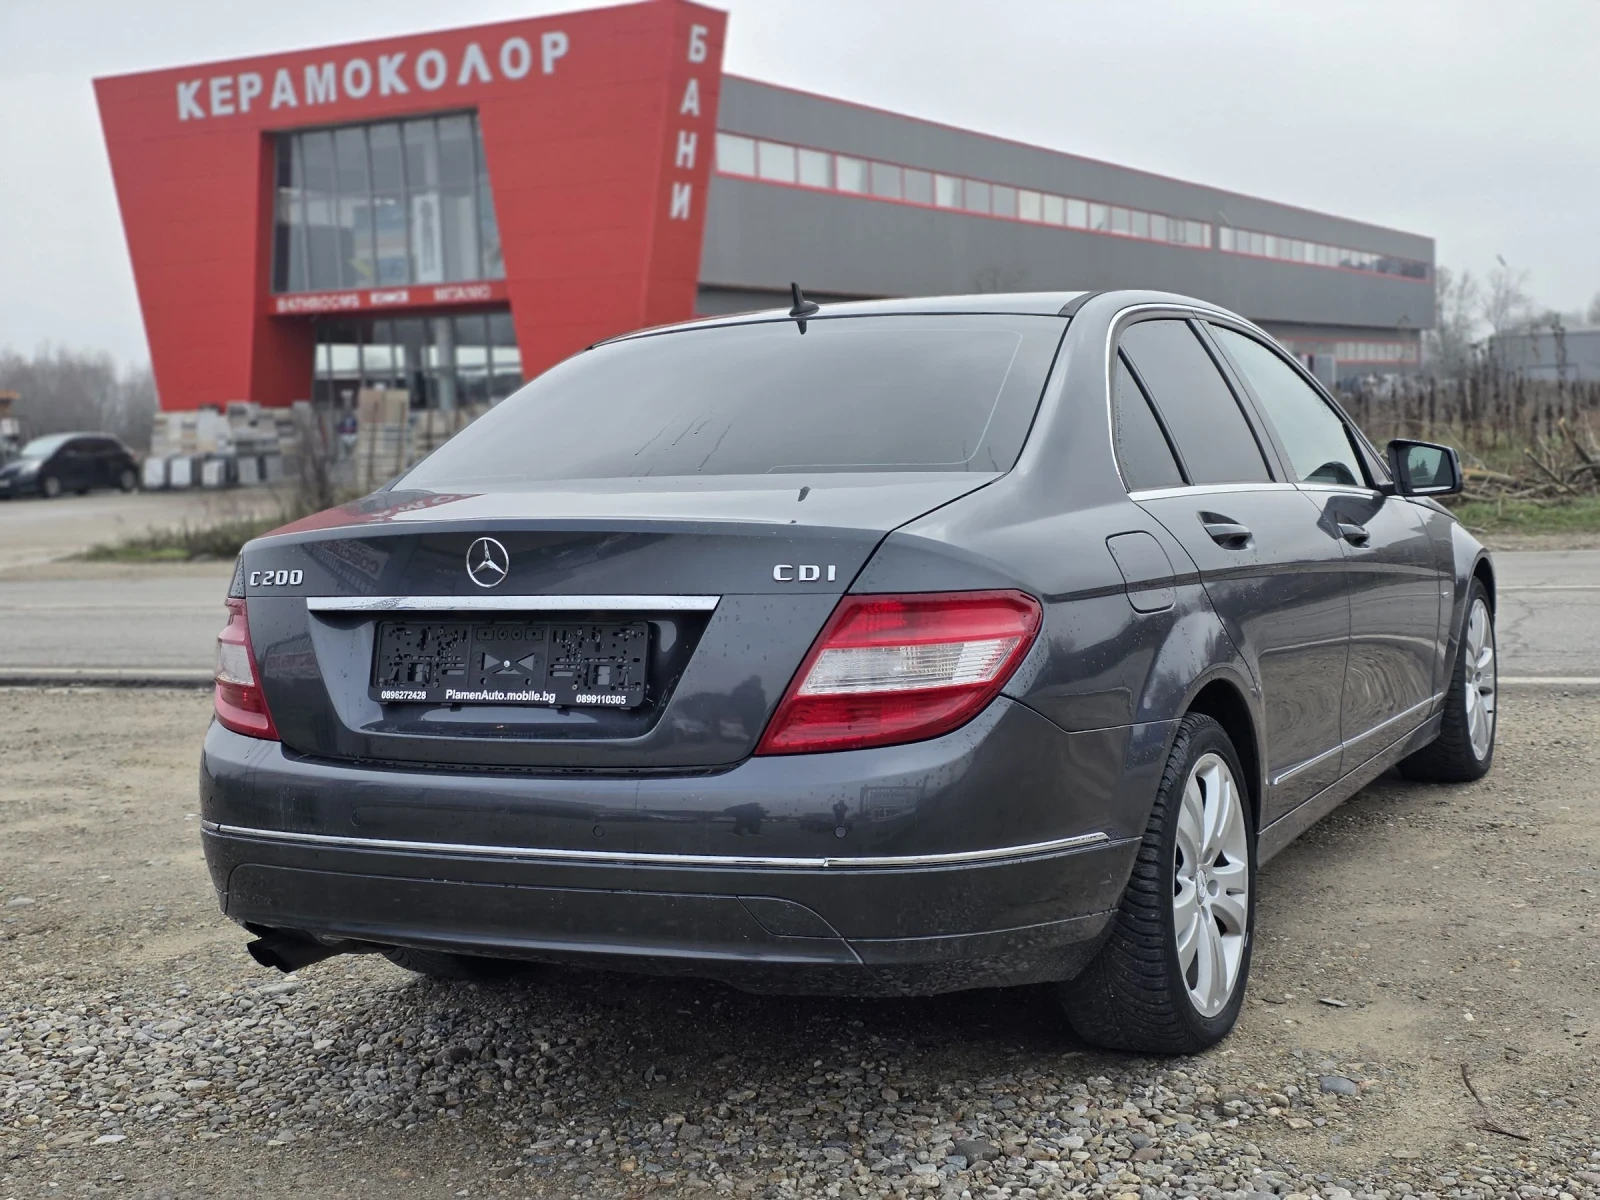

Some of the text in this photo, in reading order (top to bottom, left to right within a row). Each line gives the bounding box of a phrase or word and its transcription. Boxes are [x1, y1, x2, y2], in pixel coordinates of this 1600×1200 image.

[176, 31, 569, 122] КЕРАМОКОЛОР
[671, 24, 707, 220] БАНИ
[772, 564, 837, 582] CDI
[381, 688, 627, 705] 0896272428 PlamenAuto.mobile.bg 0899110305
